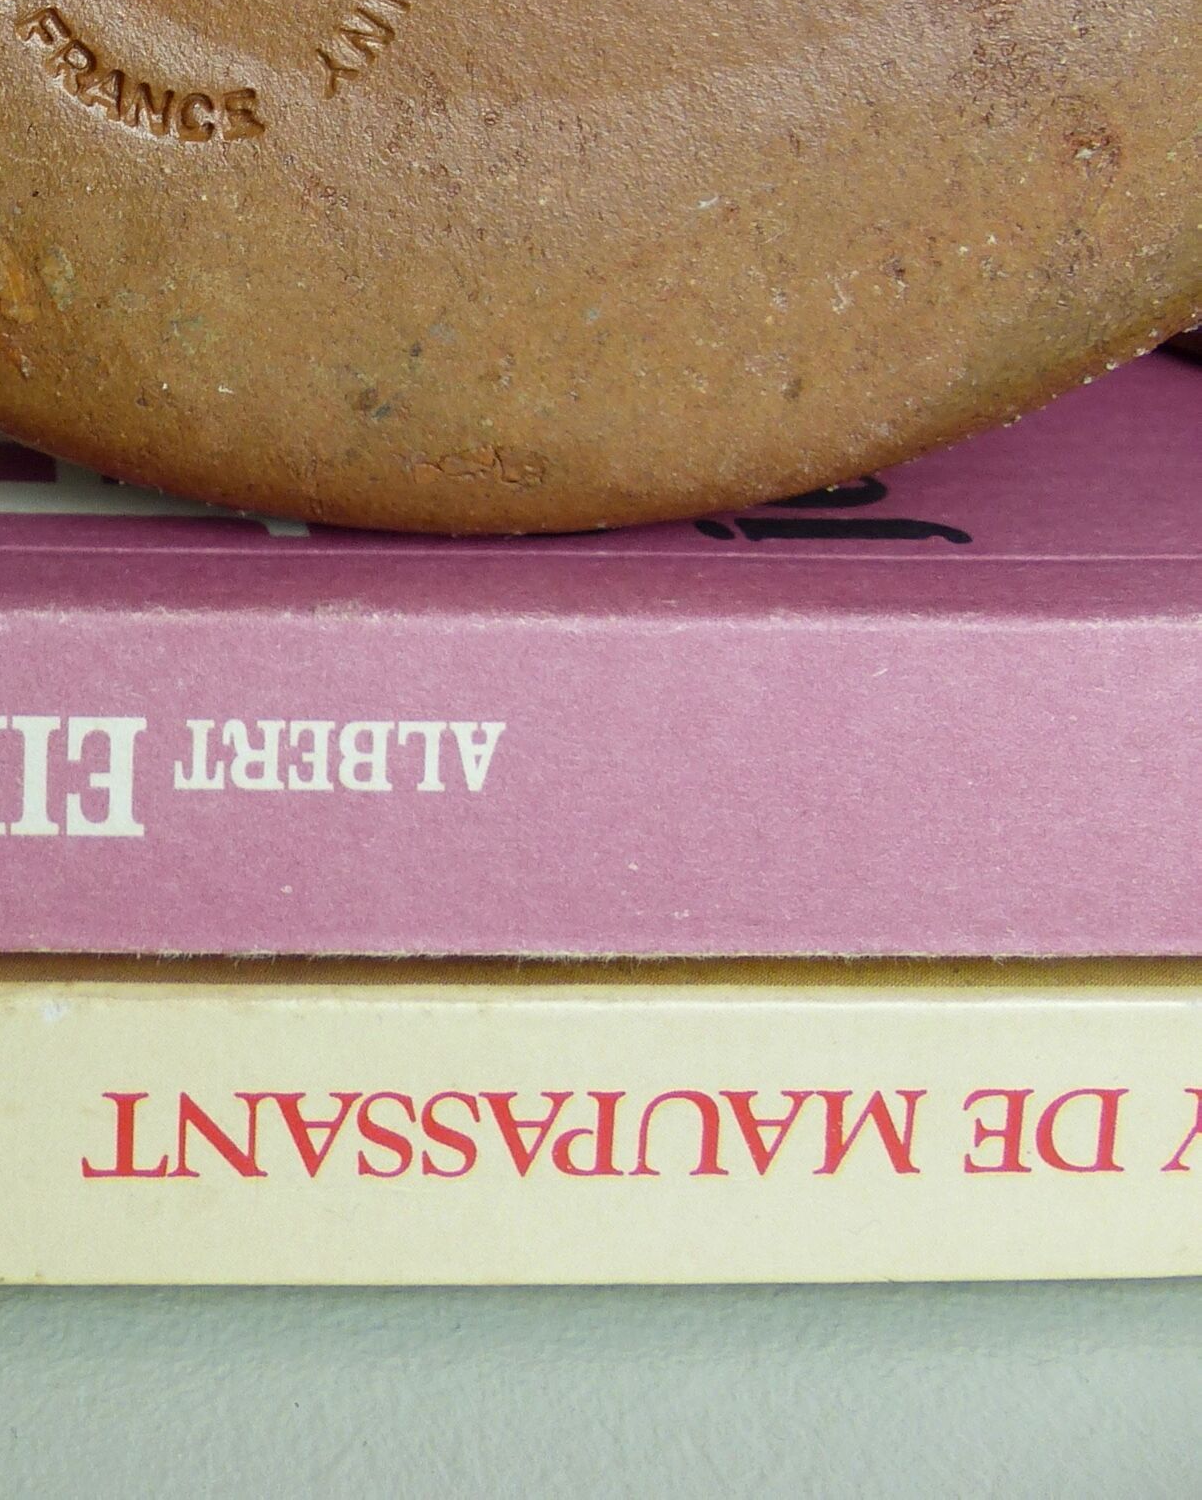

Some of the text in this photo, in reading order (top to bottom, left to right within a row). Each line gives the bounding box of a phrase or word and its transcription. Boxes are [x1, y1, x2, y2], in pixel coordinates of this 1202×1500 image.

[15, 5, 267, 143] FRANCE
[174, 719, 506, 792] ALBERT
[81, 1090, 925, 1178] MAUPASSANT
[964, 1088, 1127, 1173] DE
